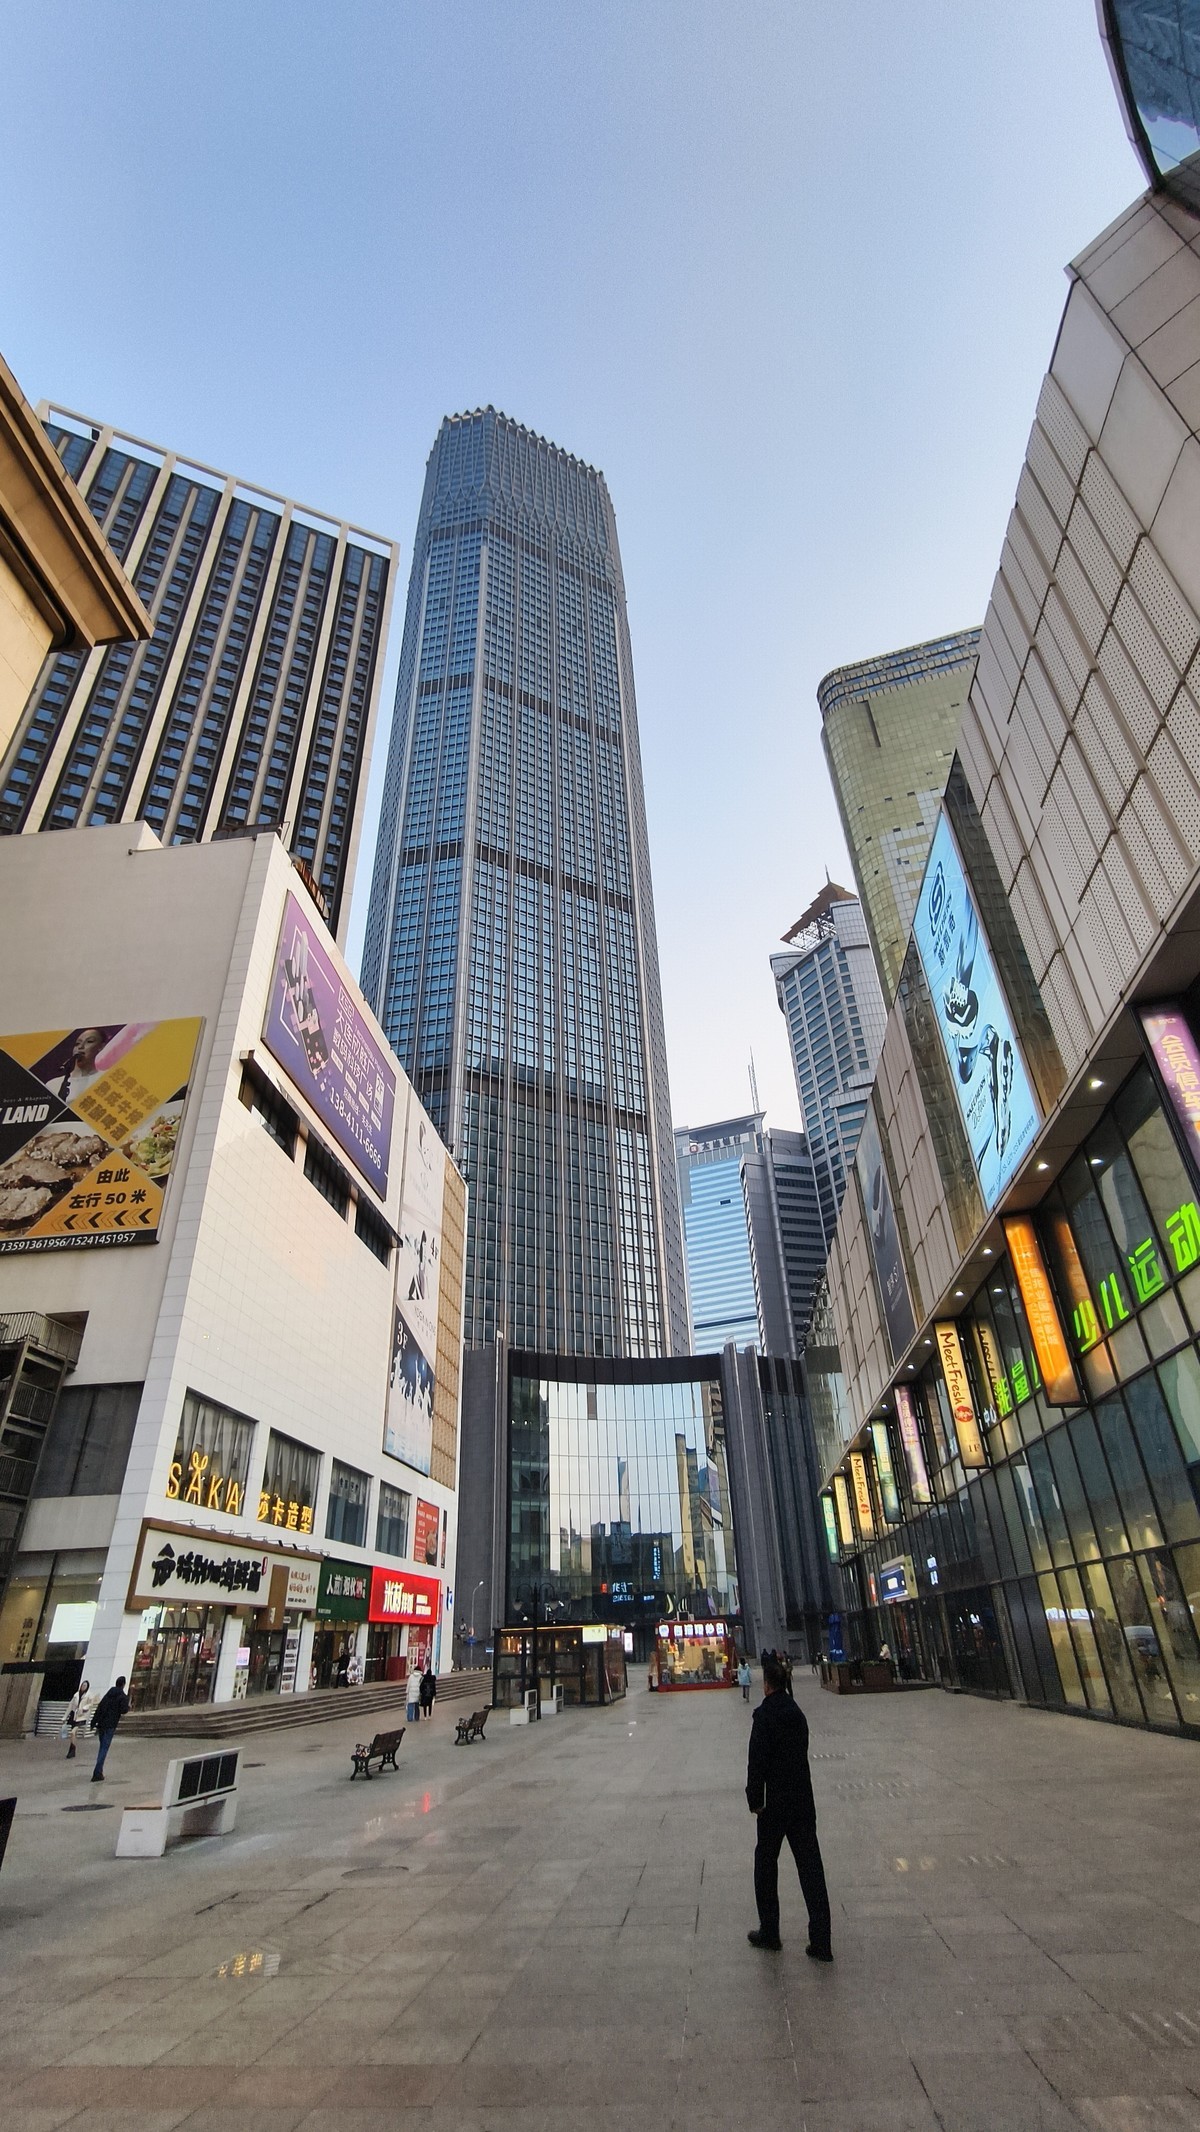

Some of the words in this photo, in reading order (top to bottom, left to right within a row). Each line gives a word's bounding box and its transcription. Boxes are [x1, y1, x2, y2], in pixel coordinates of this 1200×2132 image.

[1161, 1034, 1200, 1109] 会员停车
[2, 1104, 50, 1125] LAND
[329, 1087, 382, 1170] 138-4111-6666
[97, 1167, 131, 1185] 由此
[1, 1232, 136, 1251] 13591361956/15241451957
[396, 1321, 408, 1350] 3F
[166, 1452, 239, 1515] SAKA
[257, 1491, 313, 1534] 莎卡造型
